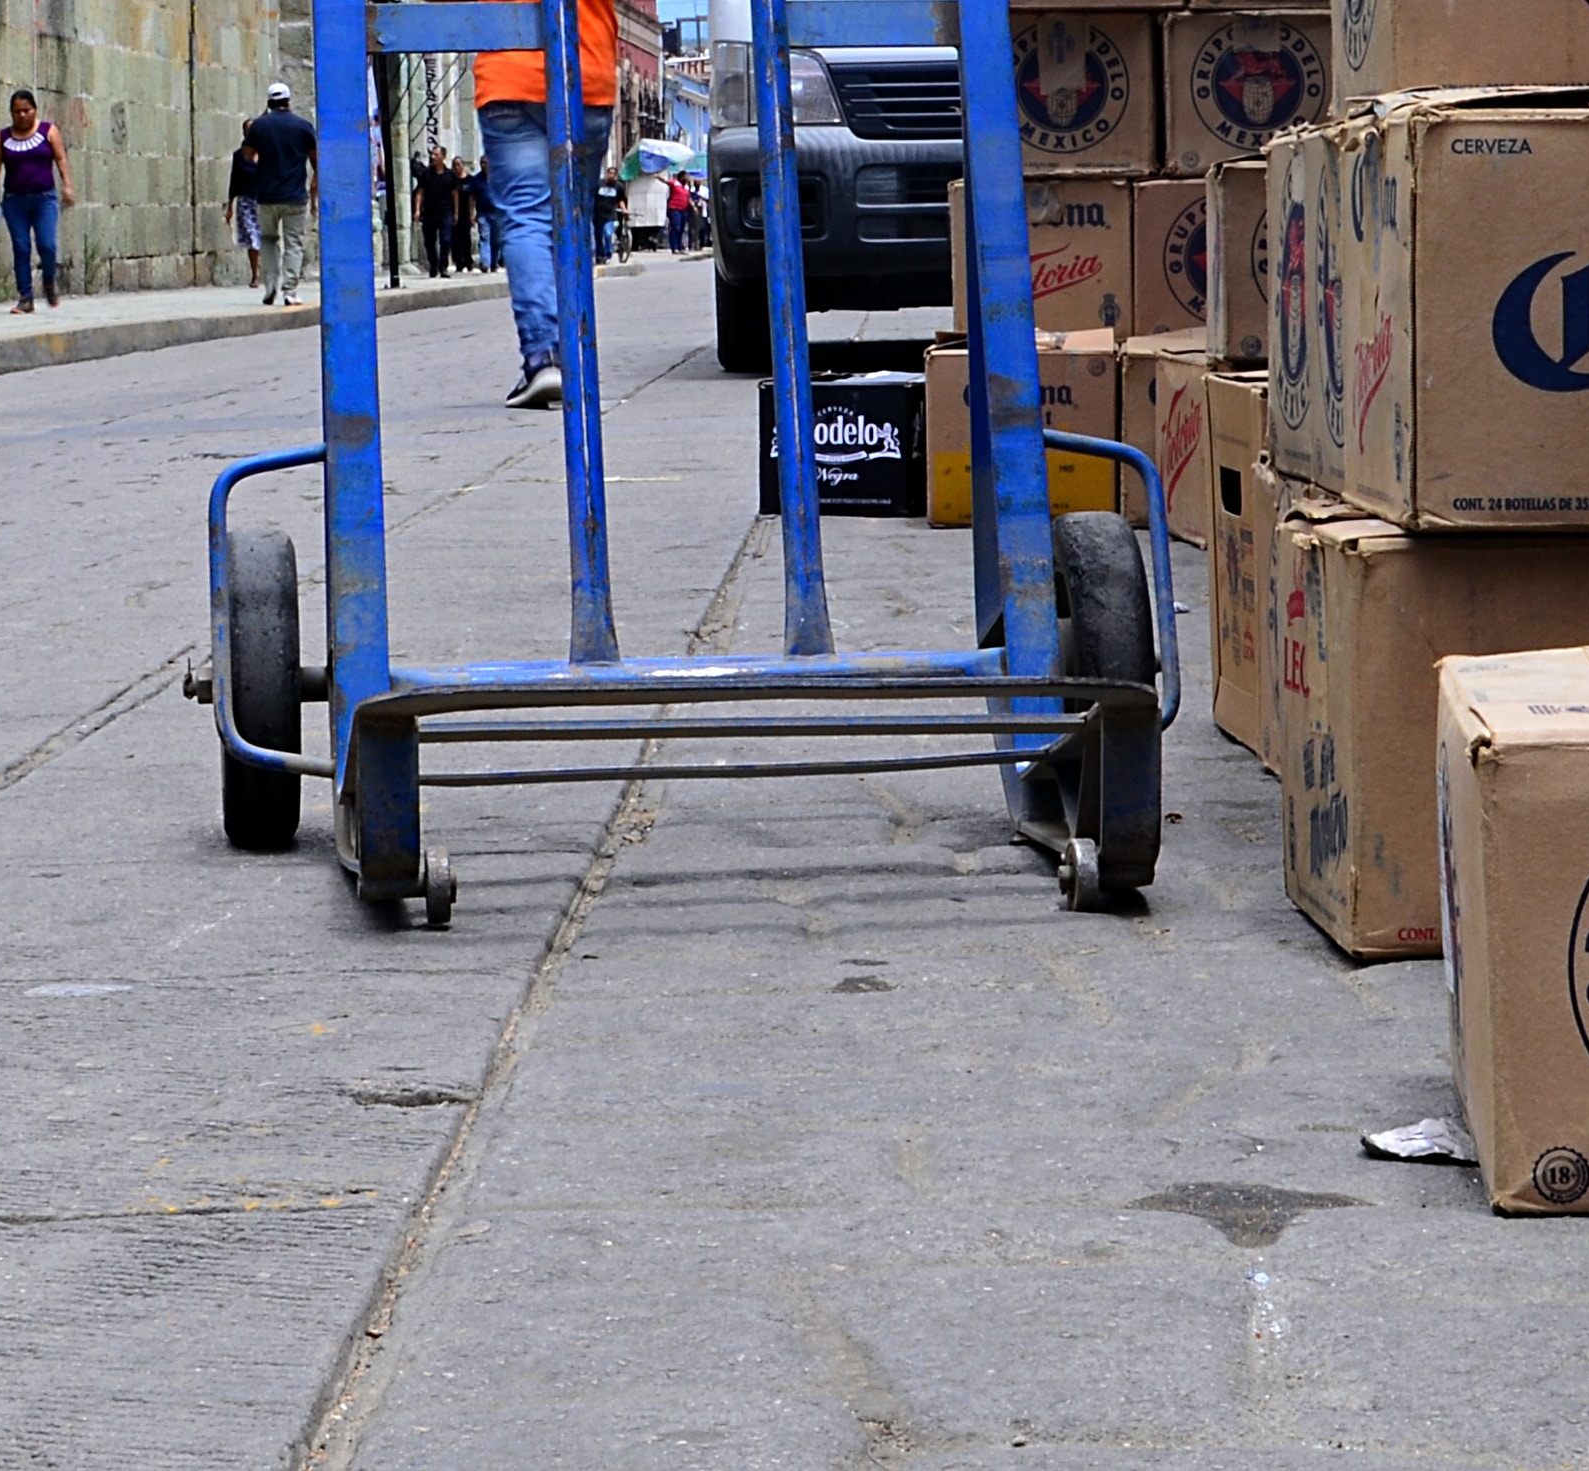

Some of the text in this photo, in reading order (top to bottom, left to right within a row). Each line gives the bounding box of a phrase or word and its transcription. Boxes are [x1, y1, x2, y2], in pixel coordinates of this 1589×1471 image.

[1280, 27, 1321, 98] ODELO
[1021, 118, 1110, 149] MEXICO
[1451, 138, 1532, 156] CERVEZA
[813, 414, 879, 446] odelo
[1453, 498, 1485, 512] CONT.
[1488, 498, 1503, 512] 24
[1505, 498, 1556, 512] BOTELLAS
[1559, 498, 1573, 512] DE
[1397, 928, 1438, 942] CONT.
[1548, 1166, 1577, 1185] 18+
